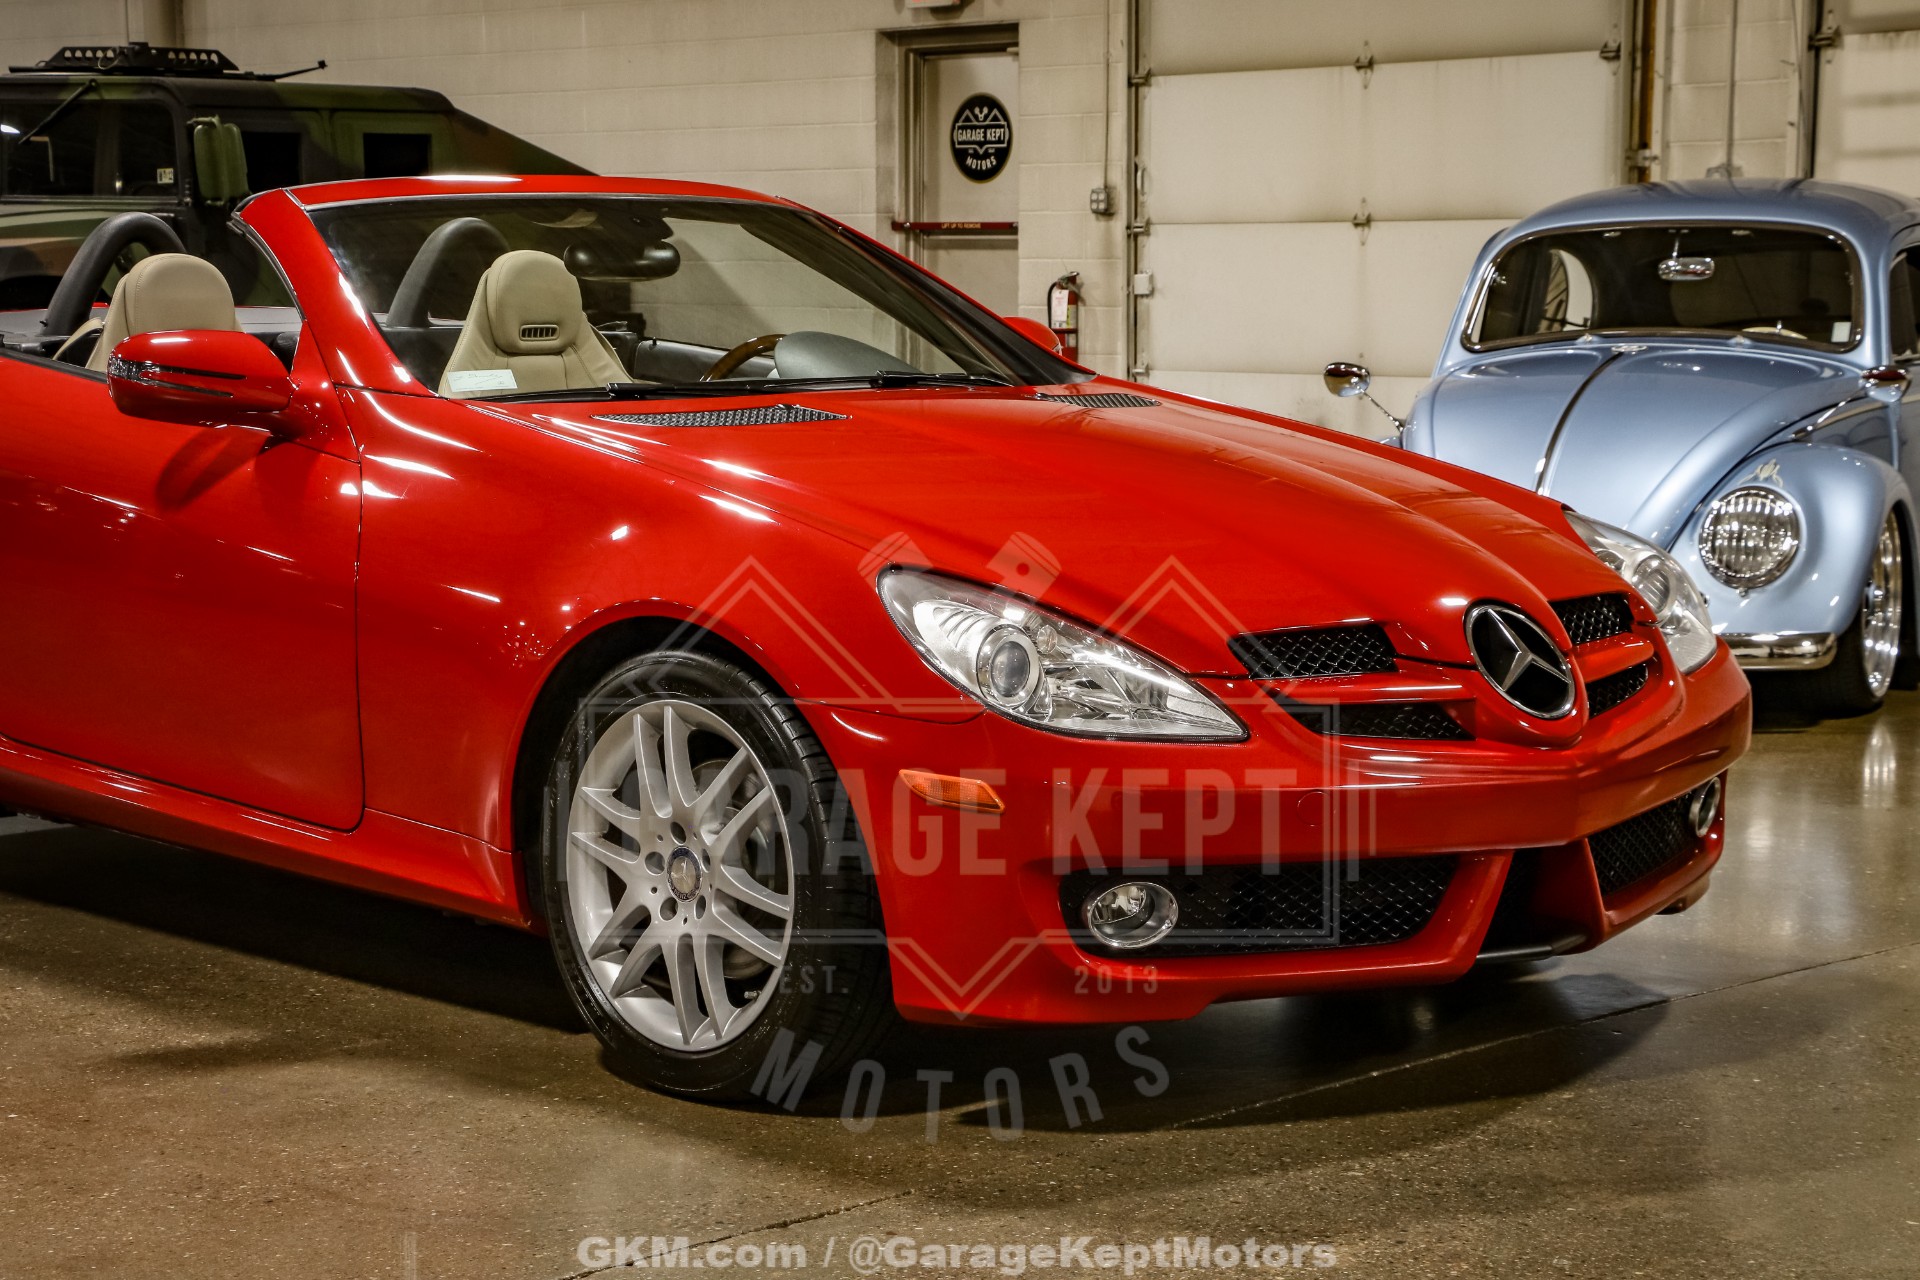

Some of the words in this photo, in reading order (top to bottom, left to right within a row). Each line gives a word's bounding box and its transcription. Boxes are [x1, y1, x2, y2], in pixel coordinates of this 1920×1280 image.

[958, 129, 985, 141] GARAGE
[986, 128, 1005, 140] KEPT
[966, 156, 997, 170] MOTORS
